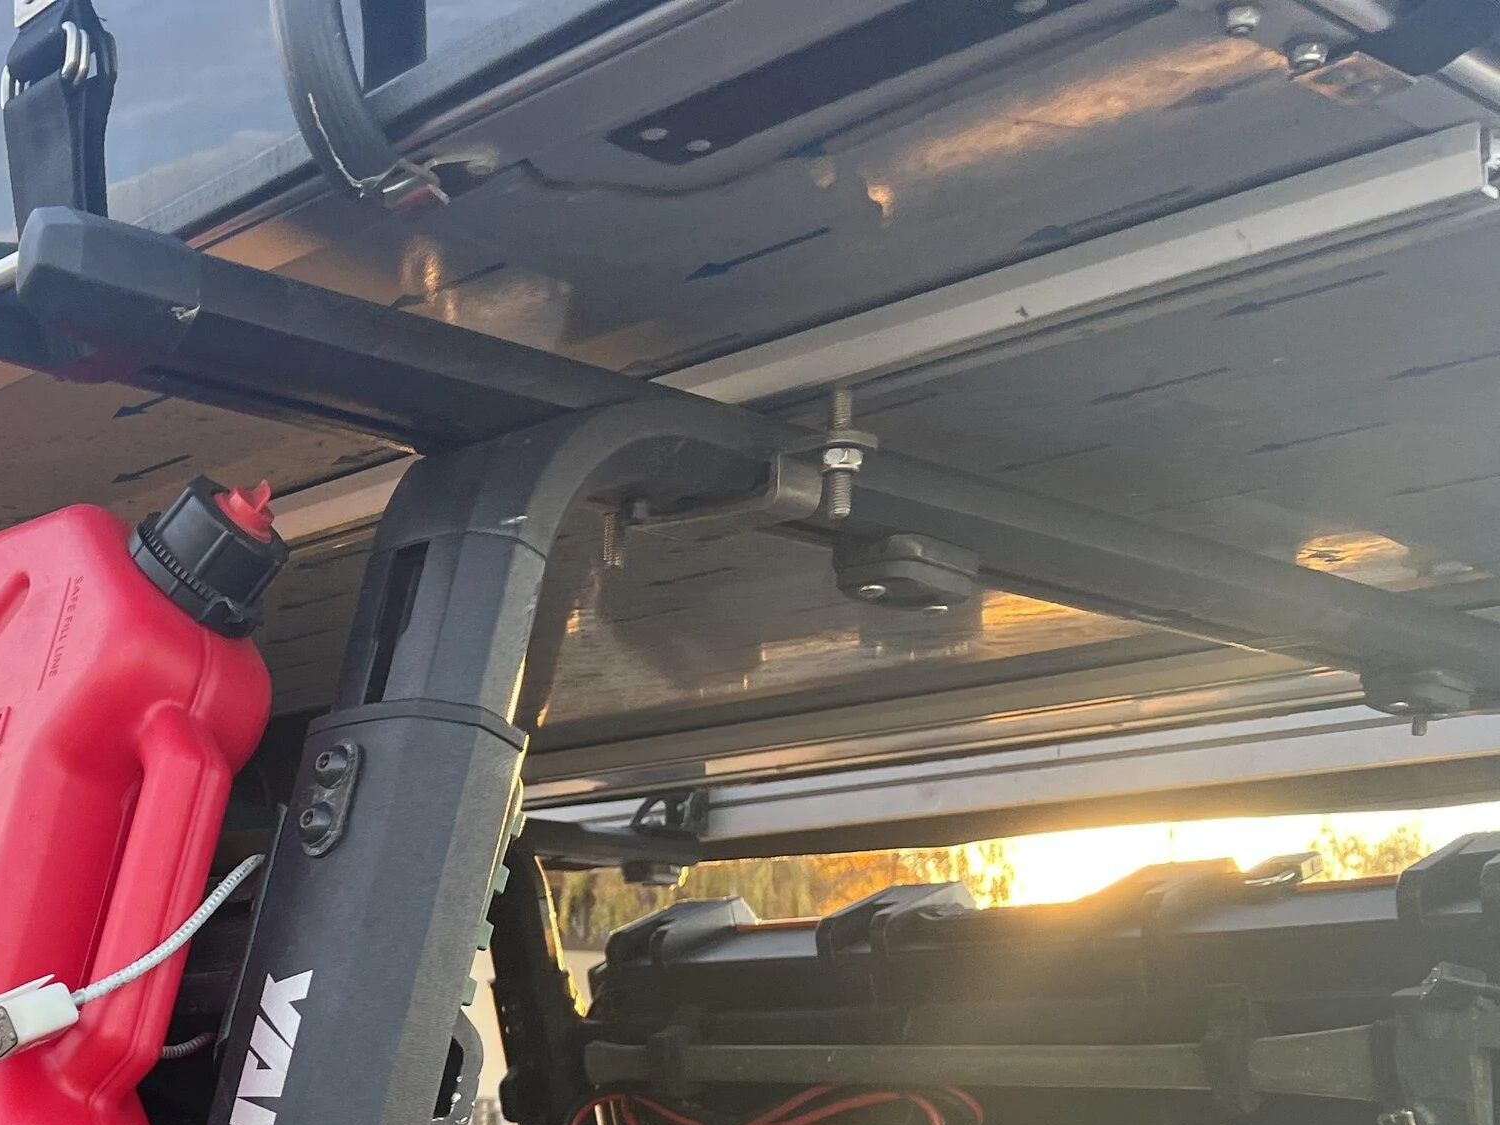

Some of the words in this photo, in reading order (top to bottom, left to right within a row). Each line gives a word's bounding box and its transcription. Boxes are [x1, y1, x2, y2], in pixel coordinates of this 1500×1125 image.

[68, 574, 84, 613] SAFE
[59, 615, 73, 641] FILL
[48, 645, 64, 678] LINE
